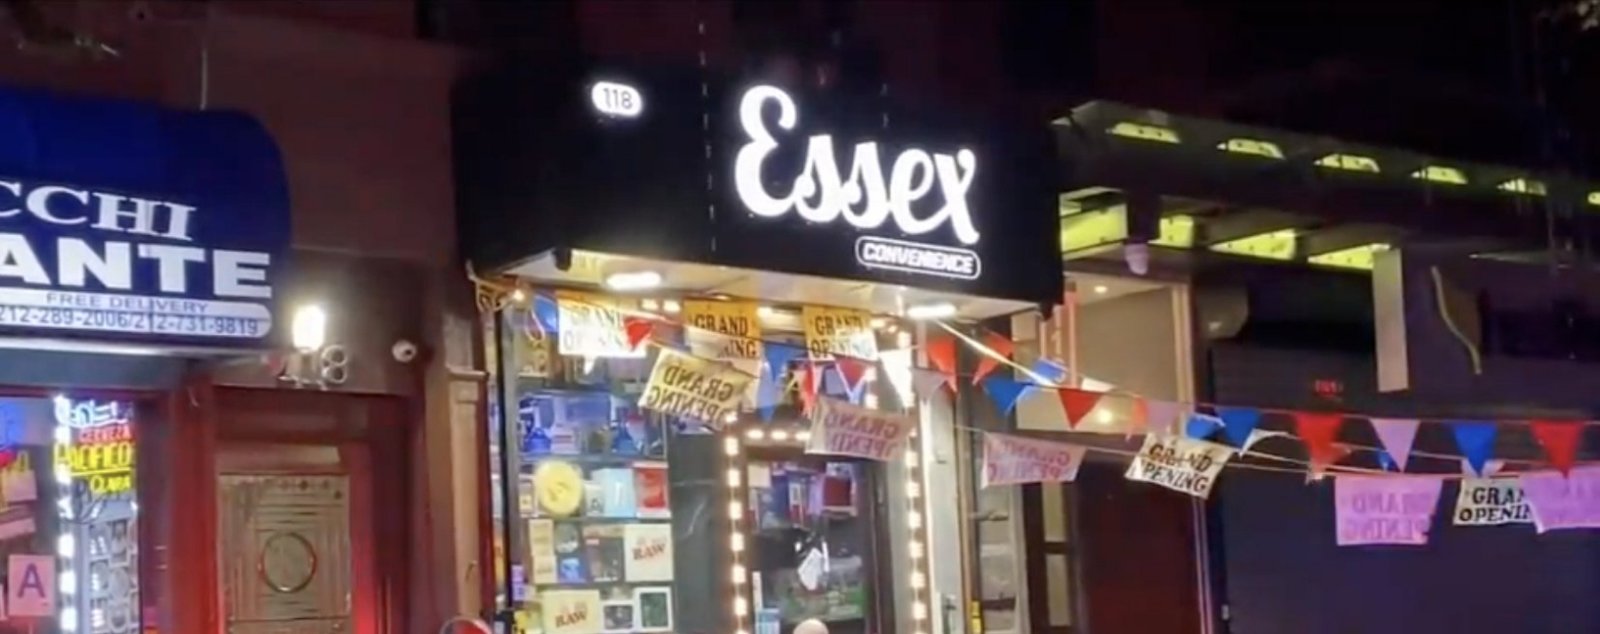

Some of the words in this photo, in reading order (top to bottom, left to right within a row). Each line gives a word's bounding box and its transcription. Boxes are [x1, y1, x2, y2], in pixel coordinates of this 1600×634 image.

[602, 87, 633, 110] 118
[735, 84, 980, 244] Essex
[862, 242, 974, 274] CONVENIENCE
[46, 293, 103, 308] FREE
[109, 297, 208, 313] DELIVERY
[694, 313, 748, 337] GRAND
[17, 563, 46, 599] A
